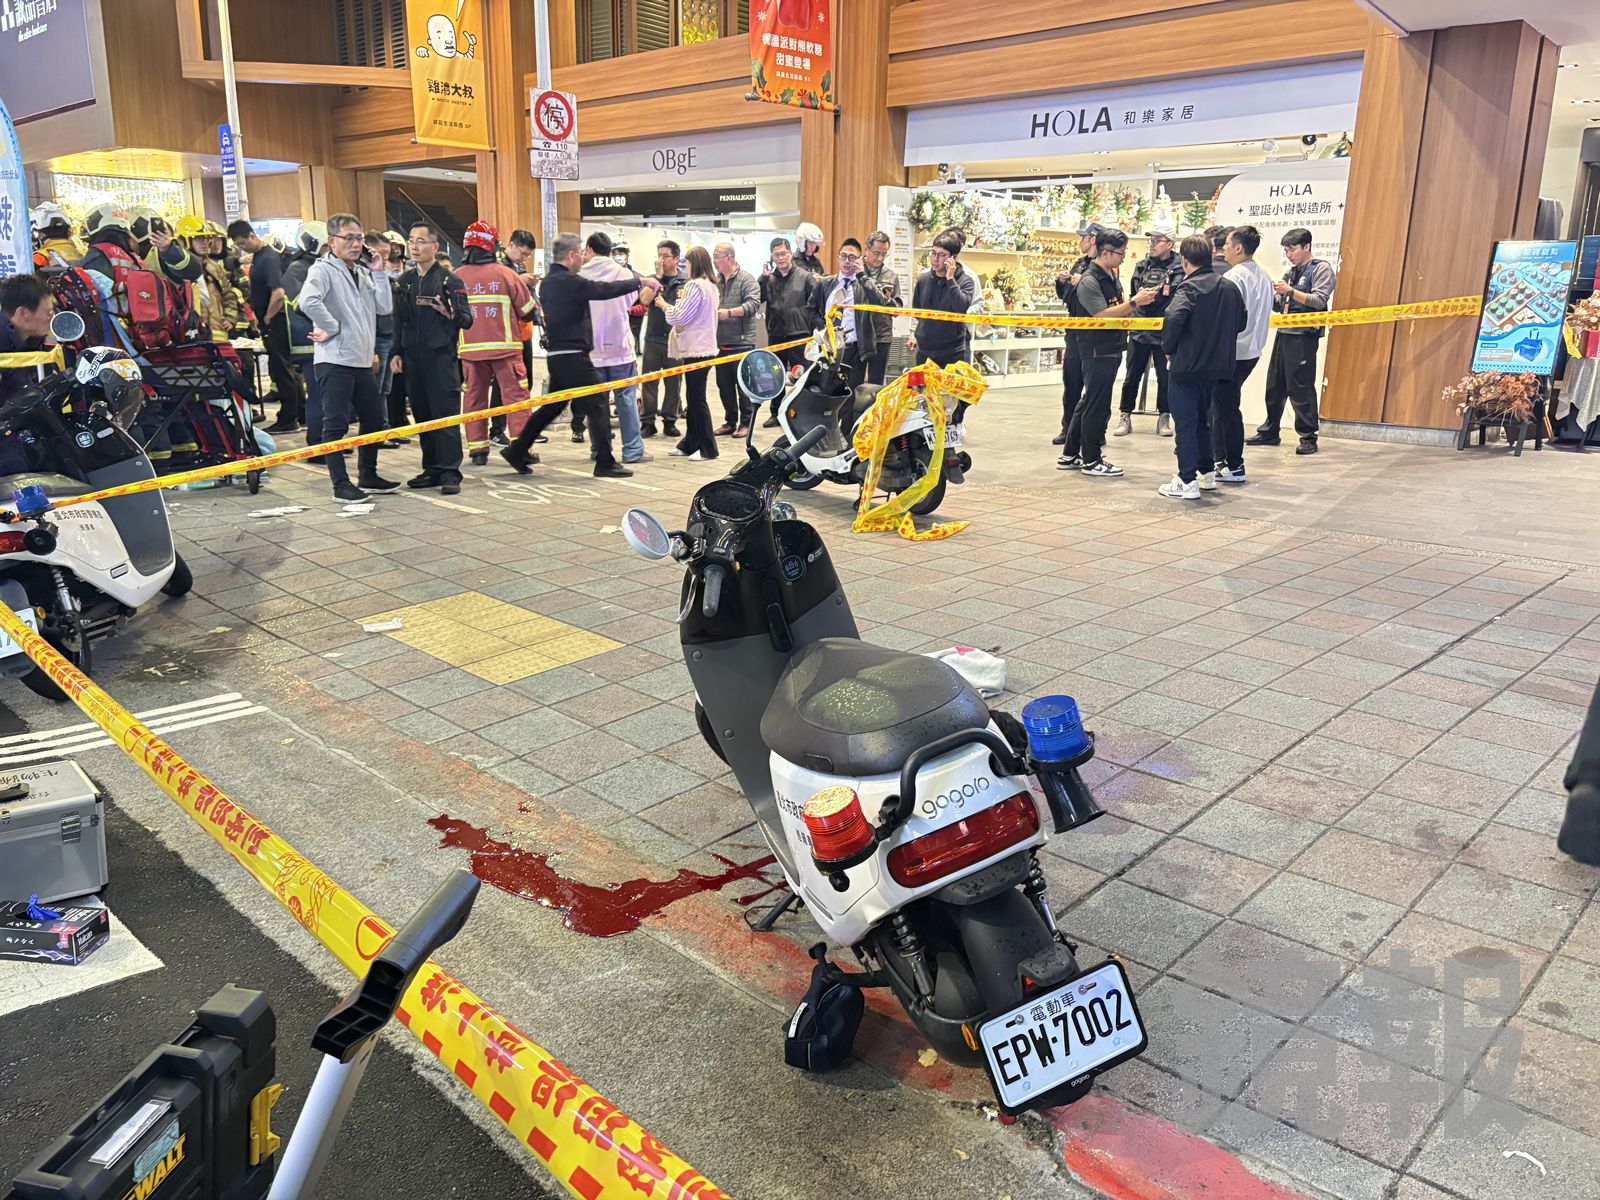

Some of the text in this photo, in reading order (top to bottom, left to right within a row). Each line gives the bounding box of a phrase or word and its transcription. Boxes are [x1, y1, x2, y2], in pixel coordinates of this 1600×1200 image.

[776, 52, 811, 70] 甜蜜登場
[544, 103, 564, 130] 停
[1031, 104, 1195, 138] HOLA 和樂家居
[556, 142, 568, 150] 110
[593, 196, 627, 208] LE LABO
[1269, 183, 1313, 197] HOLA
[1248, 201, 1332, 217] 聖誕小樹製造所
[922, 776, 990, 820] gogoro
[1030, 990, 1077, 1022] 電動車
[991, 988, 1132, 1086] EPW-7002
[122, 1132, 187, 1200] WALT
